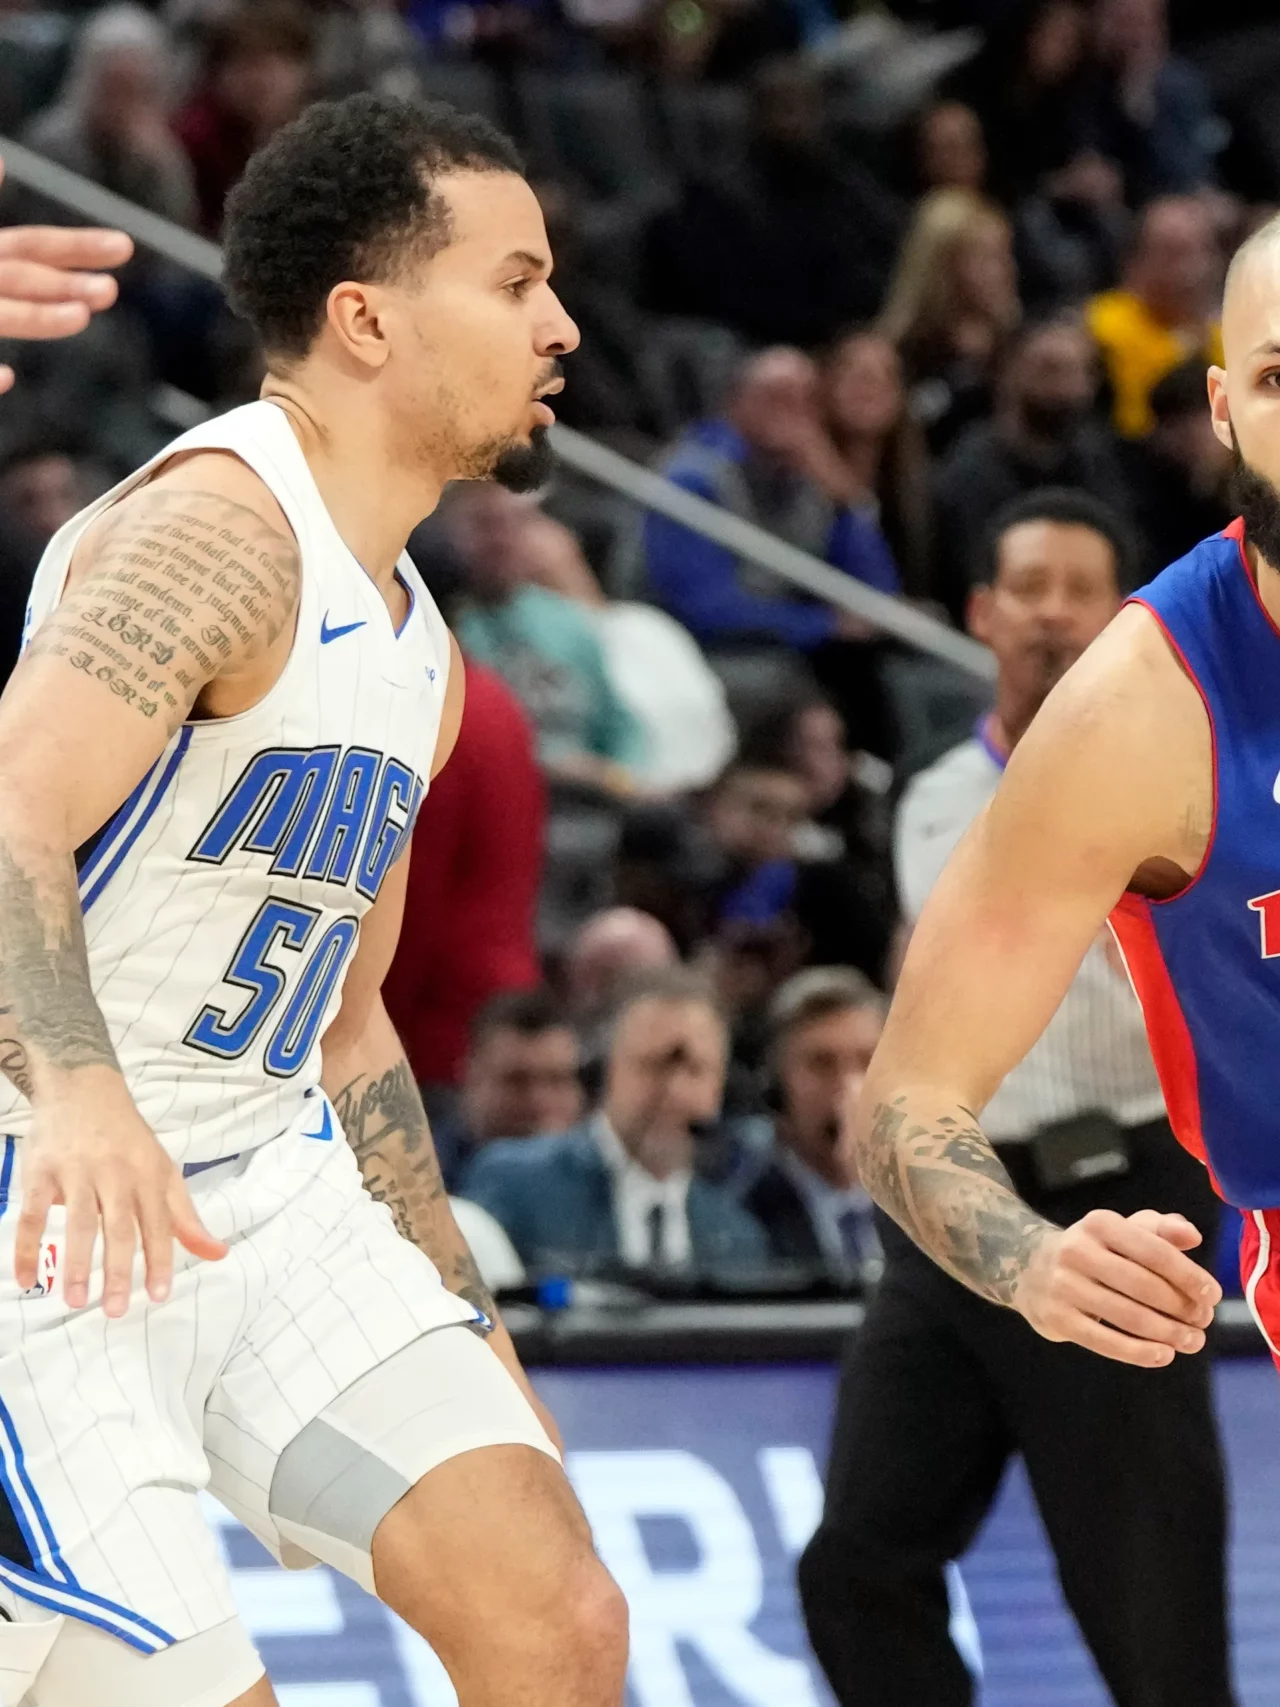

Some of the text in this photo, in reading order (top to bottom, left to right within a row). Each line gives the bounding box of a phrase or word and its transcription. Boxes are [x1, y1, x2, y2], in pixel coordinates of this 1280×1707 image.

[194, 539, 230, 563] shall
[188, 580, 206, 597] in
[211, 570, 242, 596] that
[181, 894, 360, 1080] 50
